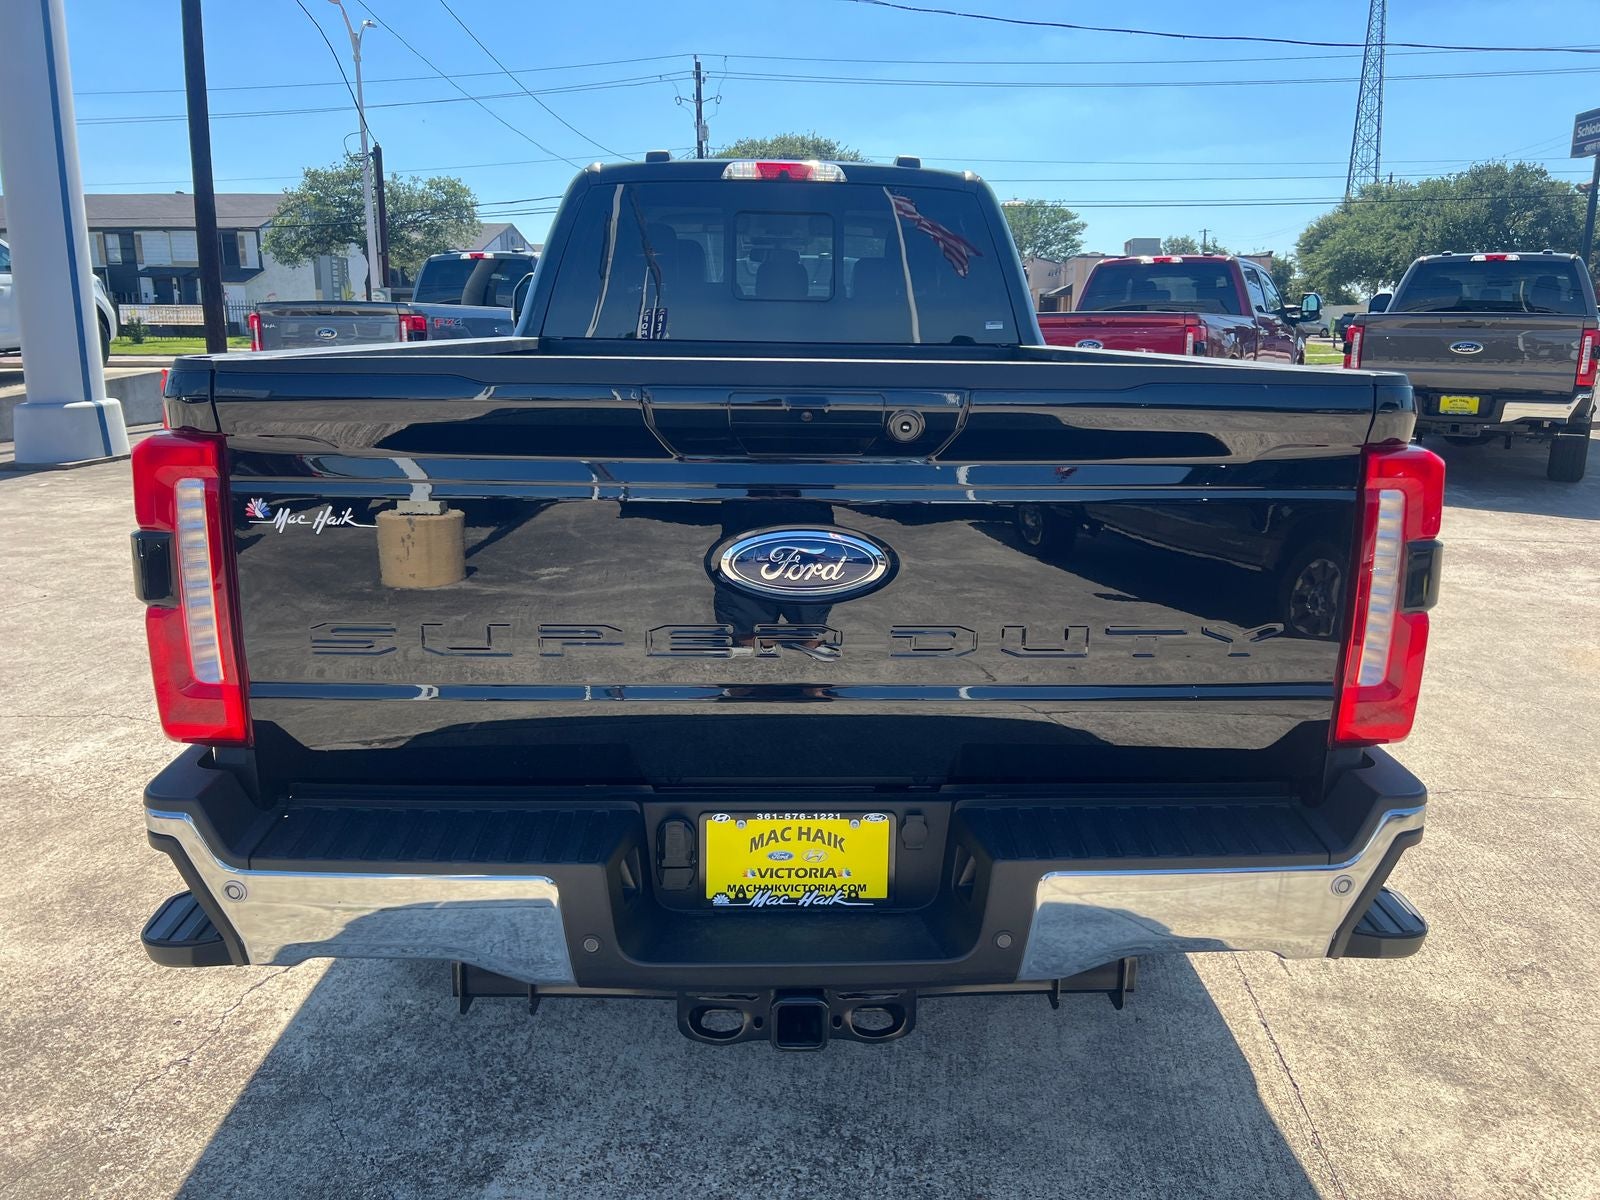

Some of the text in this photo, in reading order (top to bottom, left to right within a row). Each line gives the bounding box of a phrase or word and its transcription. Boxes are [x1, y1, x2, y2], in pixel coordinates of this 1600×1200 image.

[272, 505, 366, 535] Mac Haik
[760, 545, 847, 581] Ford
[309, 620, 1285, 660] SUPER DUTY
[749, 826, 846, 853] MAC HAIK
[757, 868, 838, 878] VICTORIA
[749, 889, 852, 908] Mac Haik
